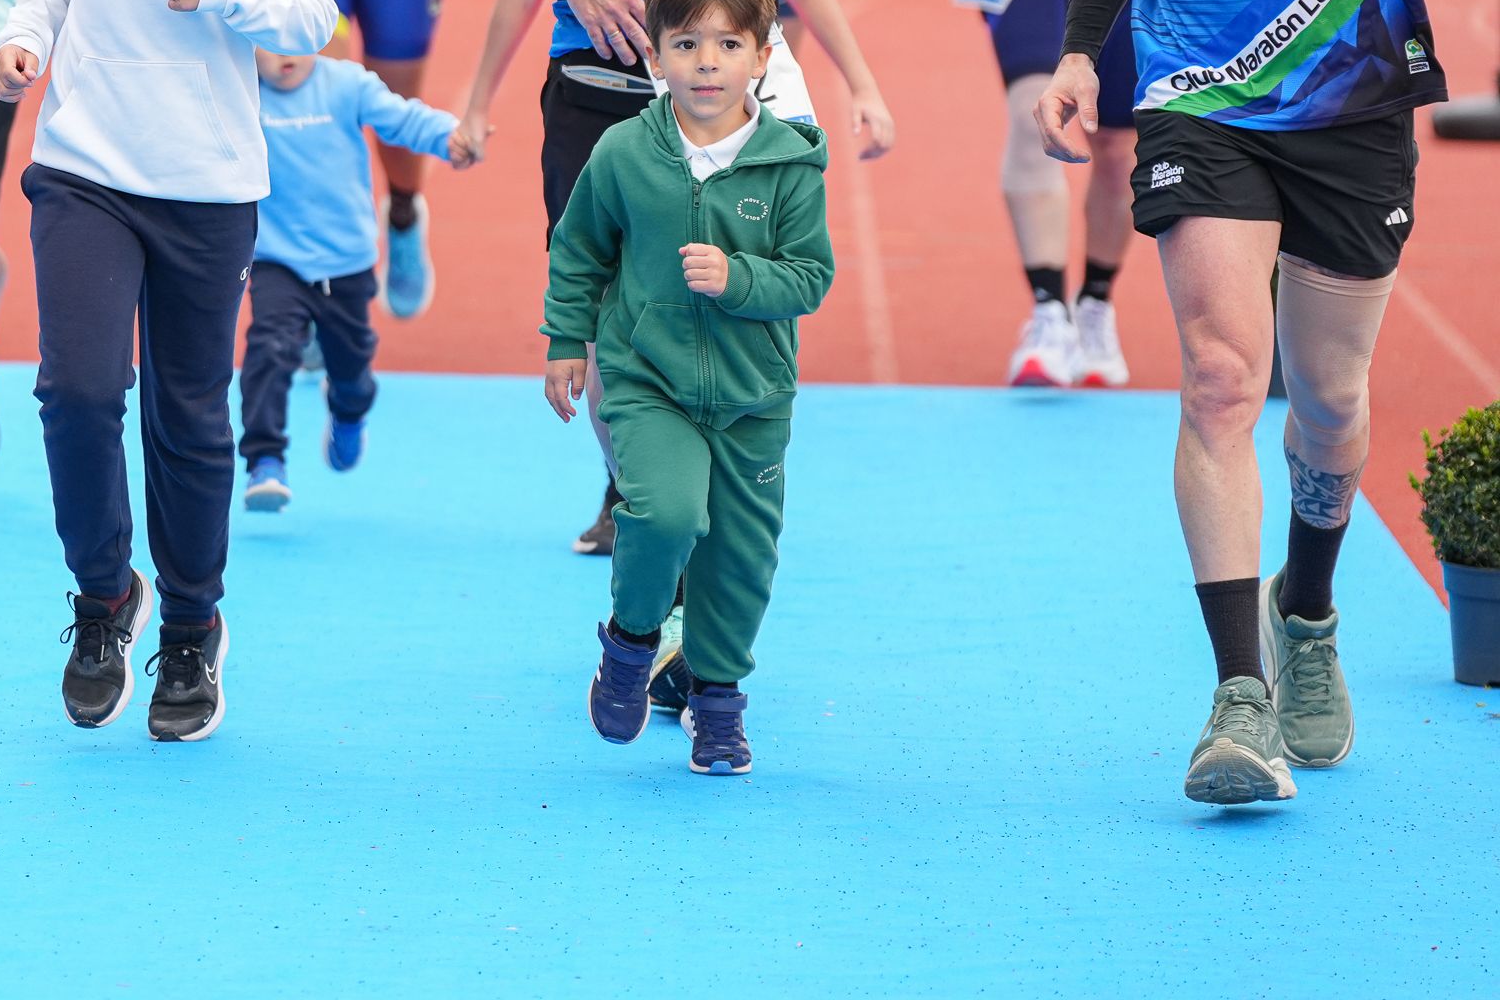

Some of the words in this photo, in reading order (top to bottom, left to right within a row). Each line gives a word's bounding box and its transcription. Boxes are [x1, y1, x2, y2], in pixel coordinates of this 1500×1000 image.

[1170, 68, 1226, 92] Club
[1225, 13, 1306, 82] Maratón
[1152, 161, 1170, 173] Club
[1152, 164, 1185, 181] Maratón
[1150, 174, 1182, 189] Lucena
